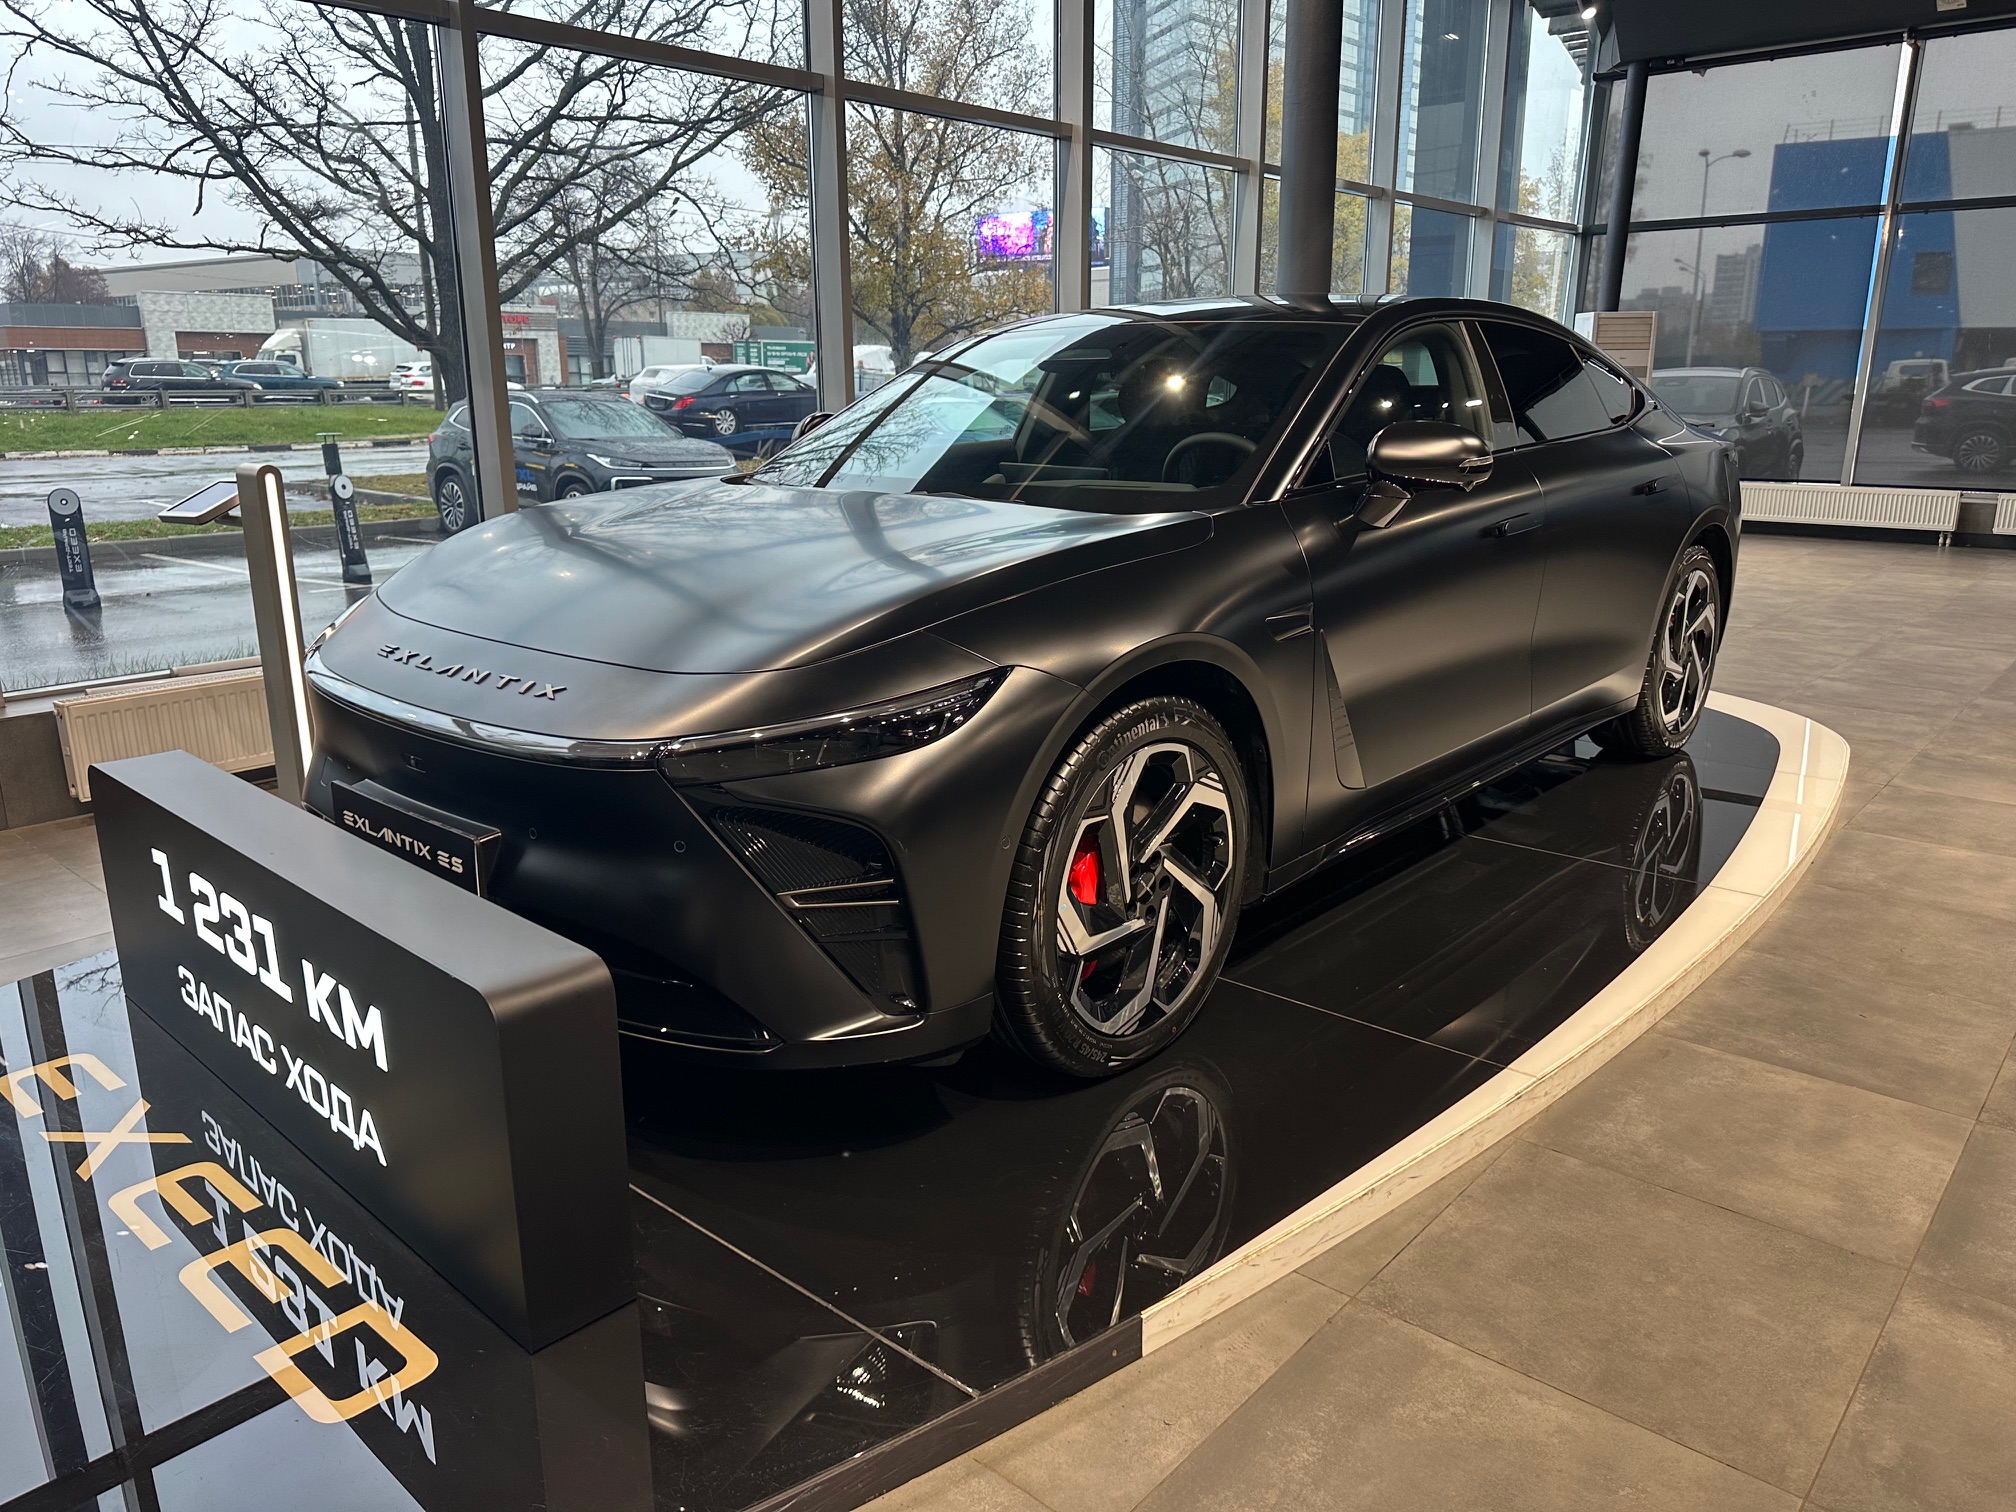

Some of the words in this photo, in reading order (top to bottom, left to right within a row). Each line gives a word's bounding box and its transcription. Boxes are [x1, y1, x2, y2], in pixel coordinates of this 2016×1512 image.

[501, 314, 531, 324] ТОРС
[516, 482, 538, 492] РАЙВ
[69, 528, 83, 573] EXEED
[377, 644, 568, 700] EXLANTIX
[343, 810, 432, 860] EXLANTIX
[437, 850, 464, 874] ES
[151, 848, 185, 925] 1
[189, 872, 293, 1003] 231
[302, 958, 389, 1073] КМ
[178, 965, 277, 1075] ЗАПАС
[281, 1045, 388, 1167] ХОДА
[0, 1053, 439, 1424] EXEED
